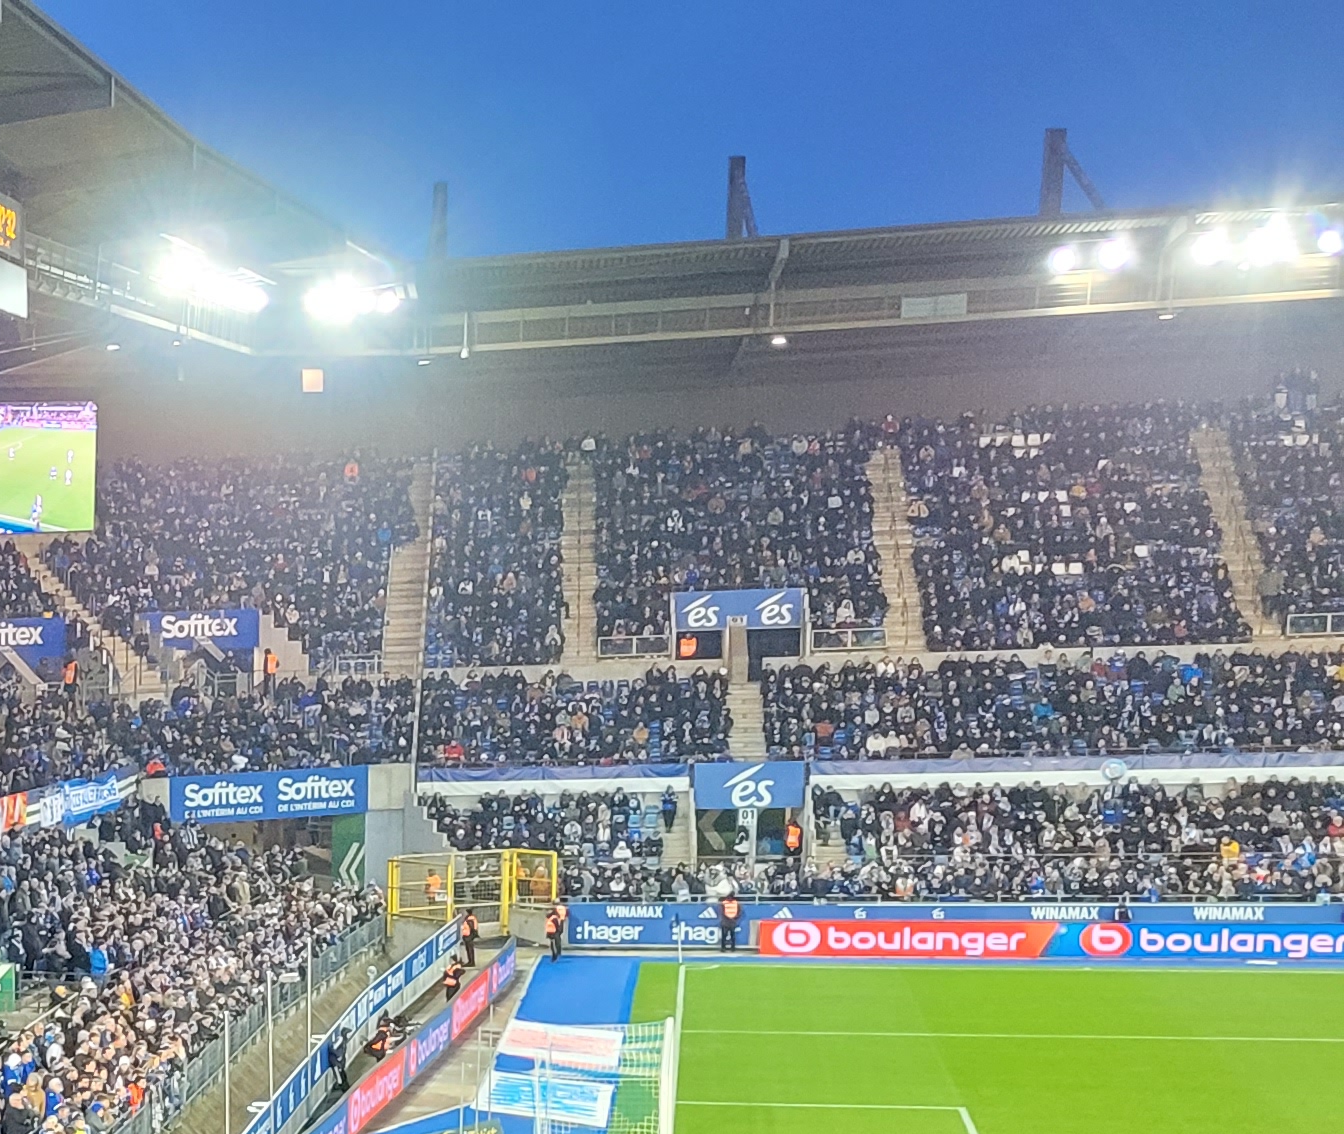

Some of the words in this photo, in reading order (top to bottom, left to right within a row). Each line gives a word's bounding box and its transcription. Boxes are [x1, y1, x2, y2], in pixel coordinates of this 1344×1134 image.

[161, 614, 238, 639] Sofitex
[184, 781, 264, 807] Sofitex
[277, 774, 355, 801] Sofitex
[606, 905, 663, 919] WINAMAX
[1030, 905, 1100, 921] WINAMAX
[1193, 905, 1265, 921] WINAMAX
[828, 925, 1027, 956] boulanger
